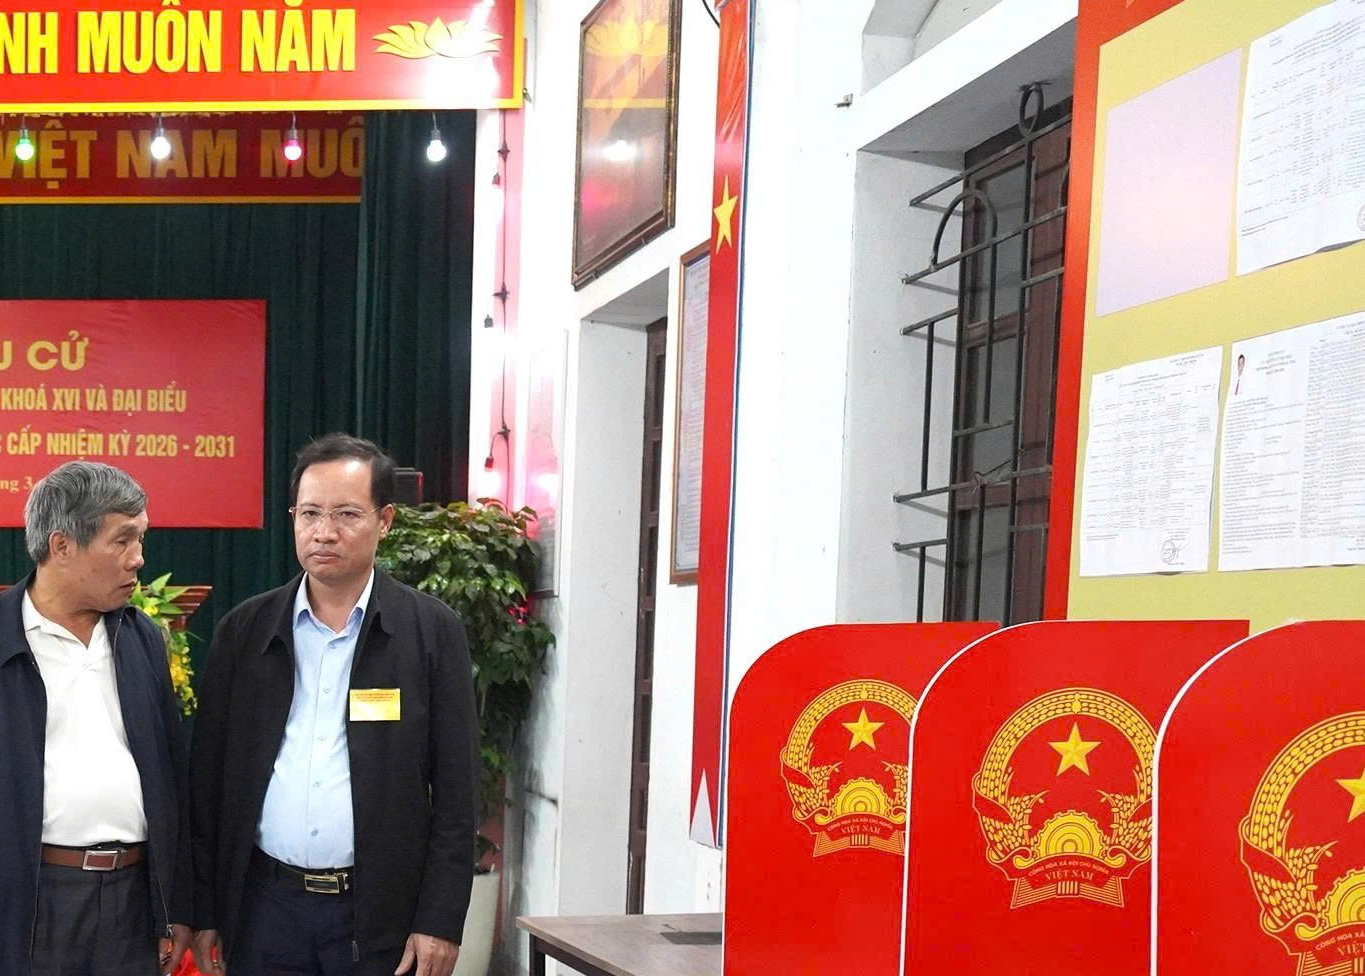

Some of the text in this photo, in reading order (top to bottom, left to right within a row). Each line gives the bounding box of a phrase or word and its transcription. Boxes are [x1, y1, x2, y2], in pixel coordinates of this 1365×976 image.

[77, 0, 222, 74] MUÔN
[240, 0, 356, 73] NĂM
[116, 129, 237, 179] NAM
[27, 330, 89, 372] CỬ
[0, 383, 48, 411] KHOÁ
[52, 387, 81, 411] XVI
[86, 384, 108, 412] VÀ
[113, 388, 142, 417] ĐẠI
[147, 380, 187, 413] BIỂU
[7, 424, 42, 456] CẤP
[46, 428, 104, 460] NHIỆM
[108, 428, 131, 457] KỲ
[135, 434, 178, 457] 2026
[194, 435, 235, 458] 2031
